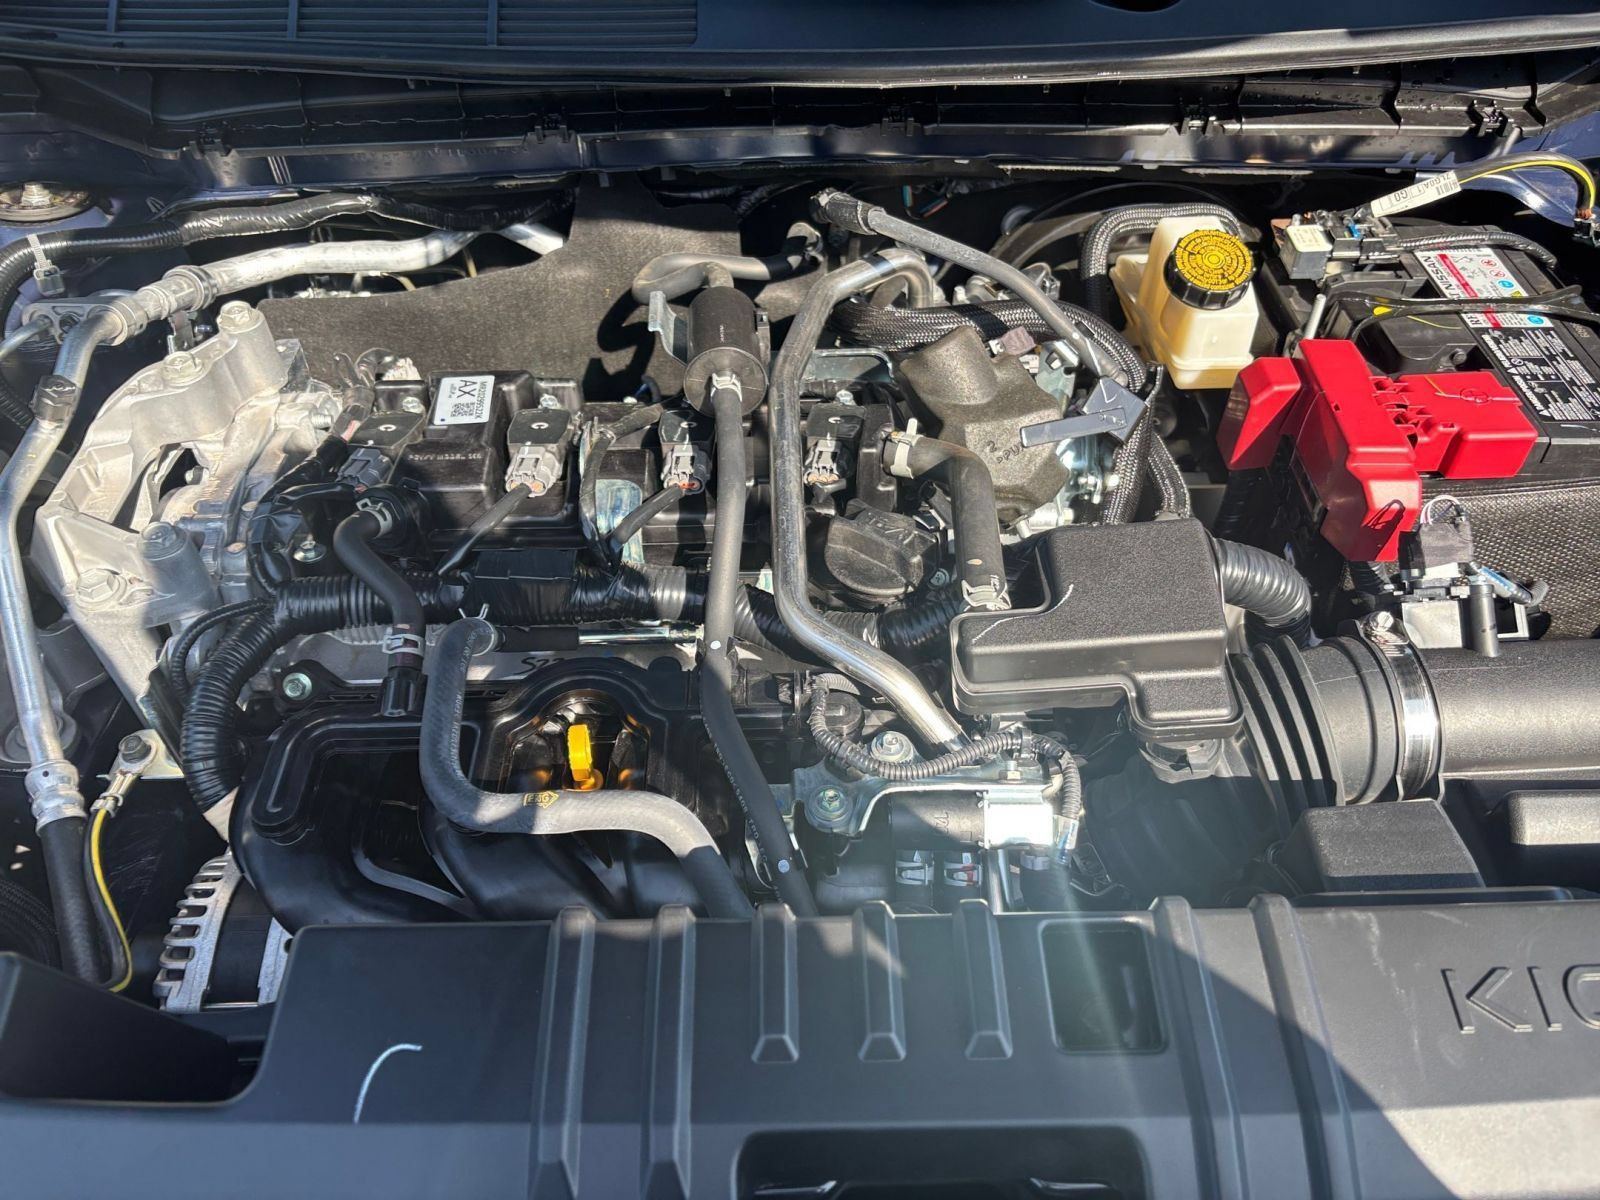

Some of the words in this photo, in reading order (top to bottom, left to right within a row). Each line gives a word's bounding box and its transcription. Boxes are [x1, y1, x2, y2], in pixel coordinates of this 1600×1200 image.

[1421, 255, 1455, 291] NISSAN
[456, 379, 476, 398] AX
[527, 793, 550, 804] ENG
